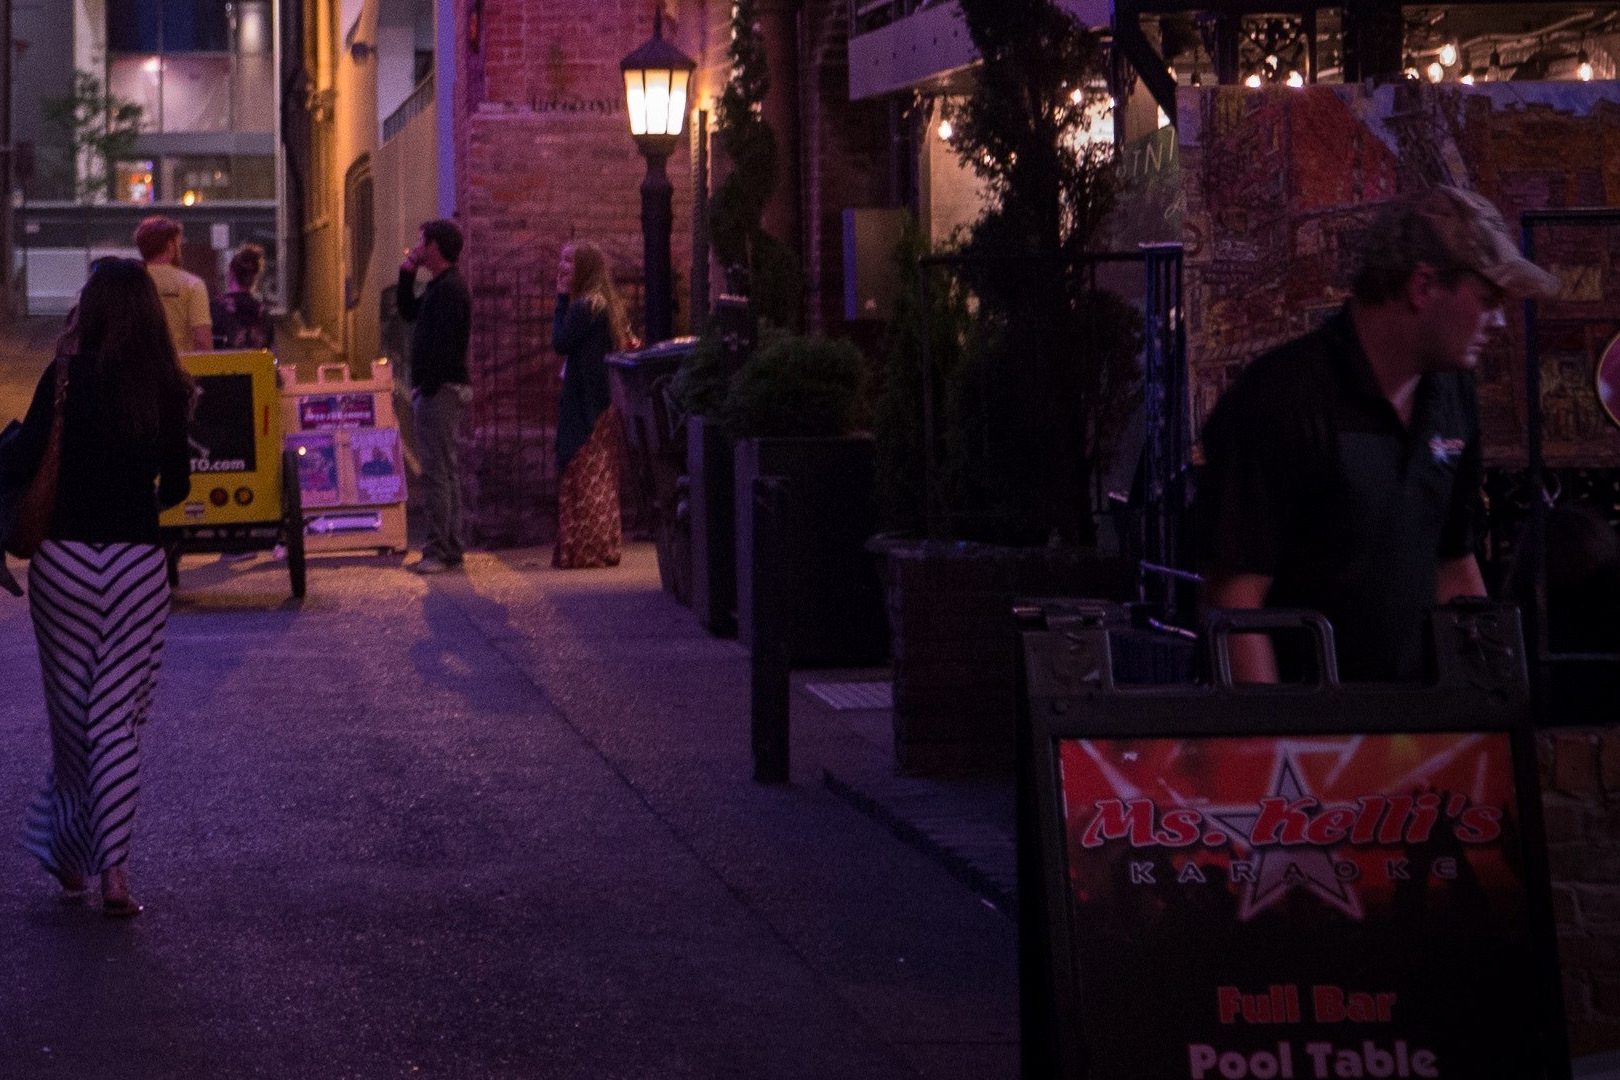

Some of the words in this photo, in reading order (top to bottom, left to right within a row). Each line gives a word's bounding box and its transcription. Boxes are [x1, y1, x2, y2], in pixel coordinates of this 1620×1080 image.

[1081, 798, 1227, 847] Ms.
[1249, 791, 1503, 846] Kelli's
[1130, 857, 1458, 884] KARAOKE
[1217, 984, 1301, 1025] Full
[1312, 984, 1398, 1024] Bar
[1188, 1041, 1293, 1080] Pool
[1305, 1038, 1440, 1079] Table
